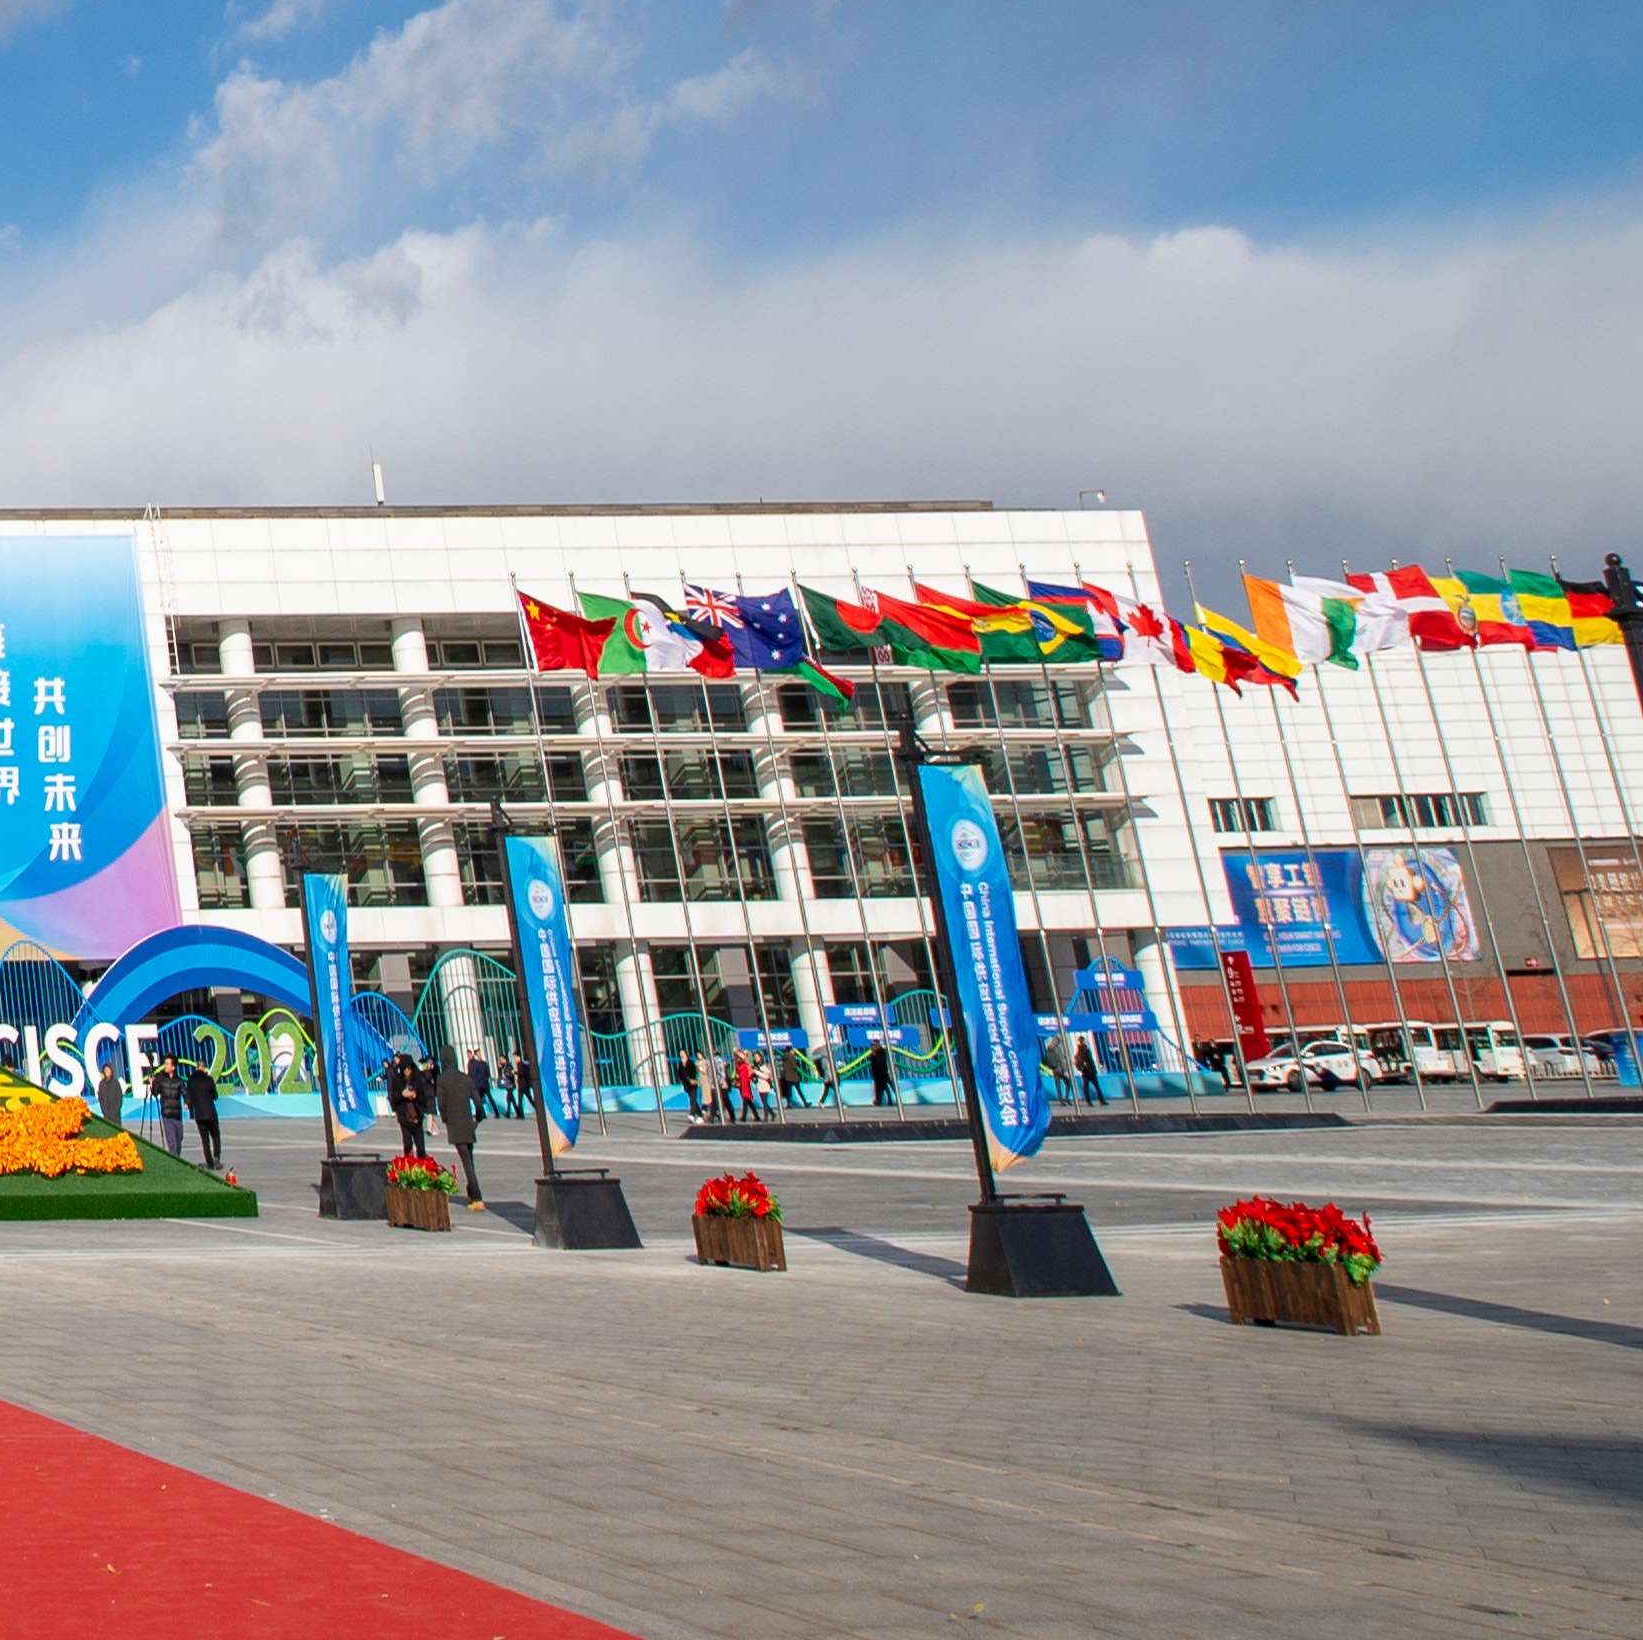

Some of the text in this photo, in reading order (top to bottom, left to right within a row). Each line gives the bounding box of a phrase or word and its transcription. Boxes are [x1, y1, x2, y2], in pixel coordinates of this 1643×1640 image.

[33, 676, 83, 862] 共创未来
[977, 881, 990, 917] China
[193, 1020, 318, 1097] 202
